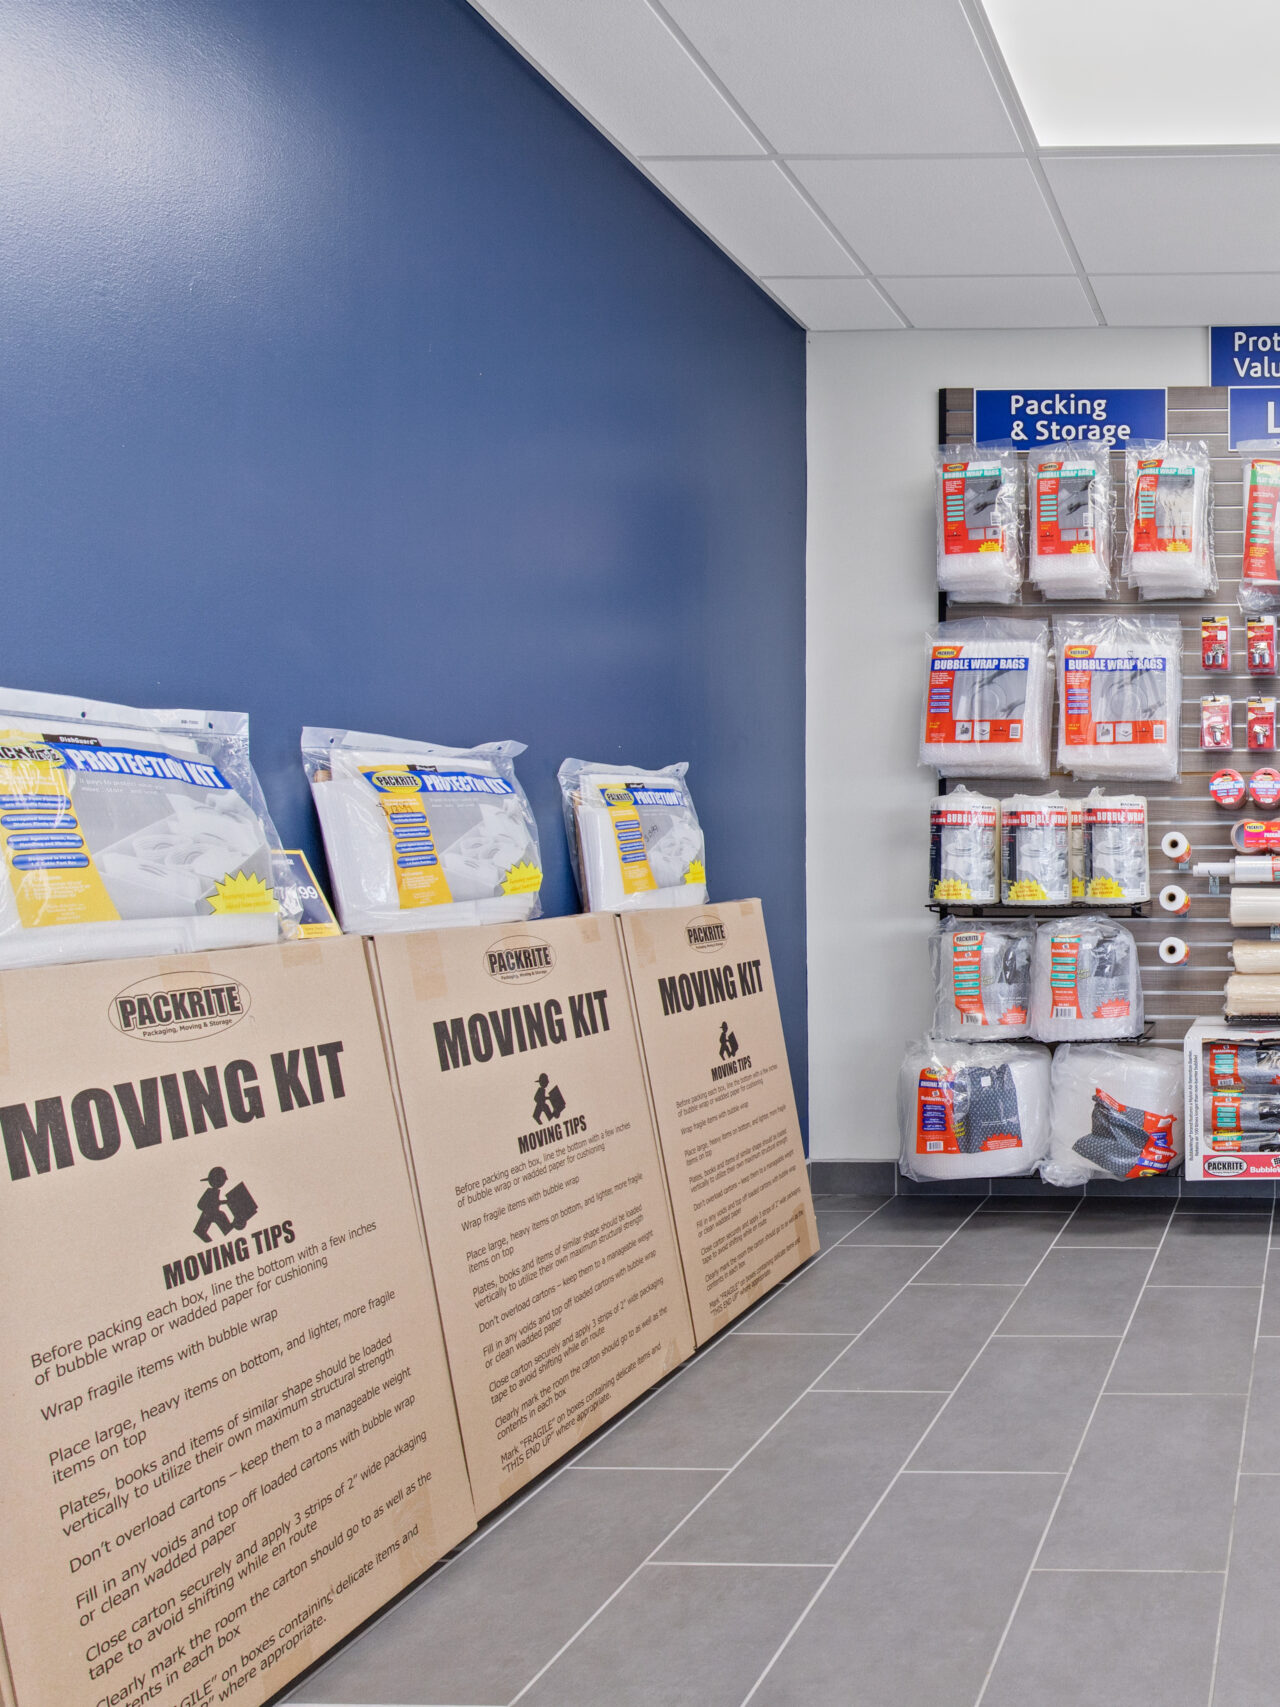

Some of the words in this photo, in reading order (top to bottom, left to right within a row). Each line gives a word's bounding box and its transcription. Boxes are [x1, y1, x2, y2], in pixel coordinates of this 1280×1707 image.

[1011, 394, 1107, 420] Packing
[1010, 422, 1028, 441] &
[1036, 421, 1131, 445] Storage
[934, 660, 970, 670] BUBBLE
[970, 660, 999, 669] WRAP
[999, 659, 1025, 669] BAGS
[1068, 660, 1106, 670] BUBBLE
[1107, 660, 1135, 670] WRAP
[184, 766, 224, 787] KIT
[375, 776, 419, 788] PACKRITE
[688, 925, 726, 944] PACKRITE
[488, 946, 551, 974] PACKRITE
[658, 964, 738, 1016] MOVING
[736, 959, 763, 997] KIT
[118, 985, 241, 1029] PACKRITE
[143, 1025, 178, 1038] Packaging,
[179, 1023, 202, 1033] Moving
[209, 1018, 233, 1028] Storage
[433, 997, 567, 1072] MOVING
[568, 989, 610, 1039] KIT
[711, 1060, 738, 1082] MOVING
[737, 1055, 753, 1072] TIPS
[0, 1059, 265, 1181] MOVING
[270, 1040, 346, 1113] KIT
[518, 1122, 563, 1154] MOVING
[563, 1114, 587, 1138] TIPS
[1207, 1162, 1245, 1171] PACKRITE
[460, 1217, 482, 1232] Wrap
[483, 1207, 506, 1223] fragile
[507, 1198, 527, 1212] items
[527, 1191, 542, 1204] with
[542, 1182, 564, 1198] bubble
[564, 1175, 580, 1188] wrap
[162, 1244, 250, 1290] MOVING
[251, 1220, 296, 1260] TIPS
[30, 1339, 83, 1368] Before
[87, 1316, 143, 1348] packing
[146, 1300, 178, 1322] each
[180, 1291, 208, 1308] box,
[211, 1280, 233, 1296] line
[235, 1271, 255, 1286] the
[256, 1255, 295, 1277] bottom
[297, 1244, 319, 1260] with
[321, 1241, 328, 1252] a
[329, 1234, 346, 1247] few
[348, 1221, 377, 1240] inches
[34, 1367, 50, 1386] of
[55, 1348, 108, 1377] bubble
[111, 1332, 147, 1354] wrap
[150, 1324, 164, 1338] or
[168, 1300, 218, 1330] wadded
[221, 1287, 253, 1311] paper
[256, 1279, 271, 1293] for
[275, 1256, 328, 1286] cushioning
[40, 1395, 83, 1421] Wrap
[87, 1373, 133, 1401] fragile
[137, 1355, 174, 1379] items
[177, 1340, 205, 1361] with
[207, 1322, 248, 1347] bubble
[250, 1309, 278, 1328] wrap
[69, 1541, 112, 1574] Don't
[115, 1502, 176, 1547] overload
[179, 1475, 227, 1510] cartons
[240, 1451, 269, 1474] keep
[270, 1433, 300, 1456] them
[301, 1425, 313, 1438] to
[315, 1420, 323, 1431] a
[325, 1386, 380, 1424] manageable
[382, 1367, 412, 1390] weight
